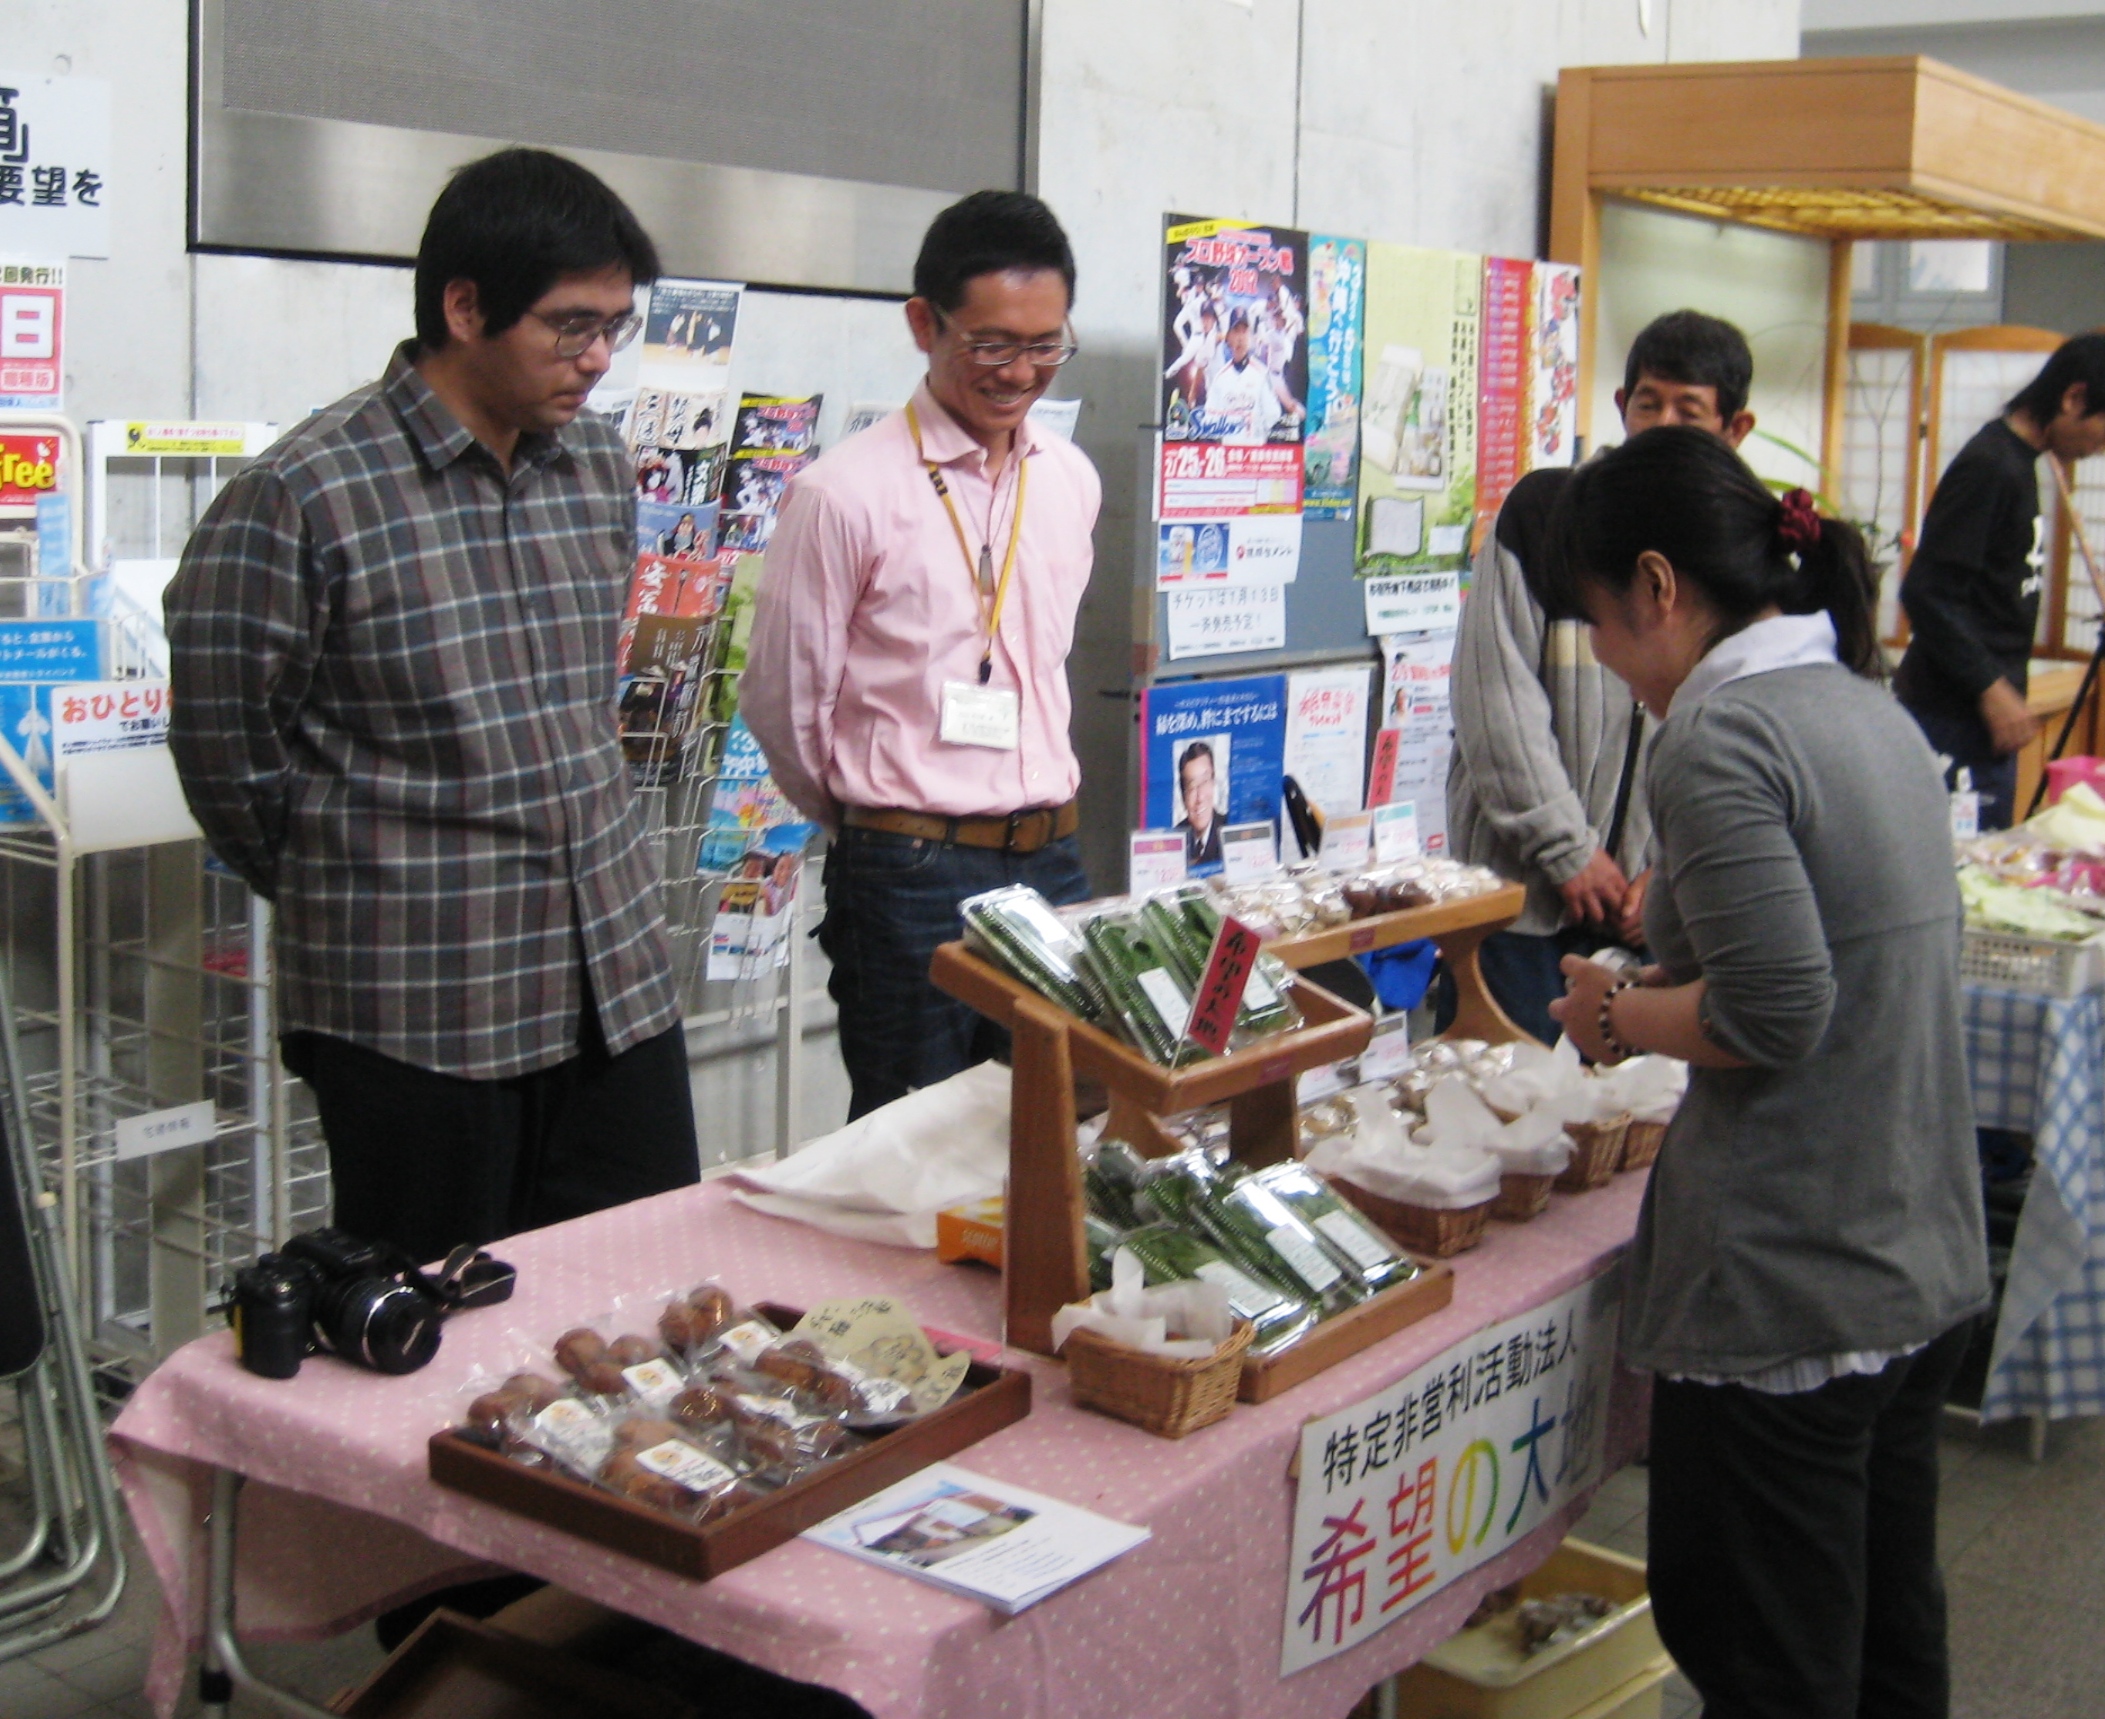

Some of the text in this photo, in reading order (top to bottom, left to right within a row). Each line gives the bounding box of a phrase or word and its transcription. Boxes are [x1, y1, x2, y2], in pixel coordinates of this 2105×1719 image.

[0, 444, 55, 490] ree
[1322, 1308, 1578, 1495] 特定非営利活動法人
[1298, 1365, 1598, 1645] 希望の大地
